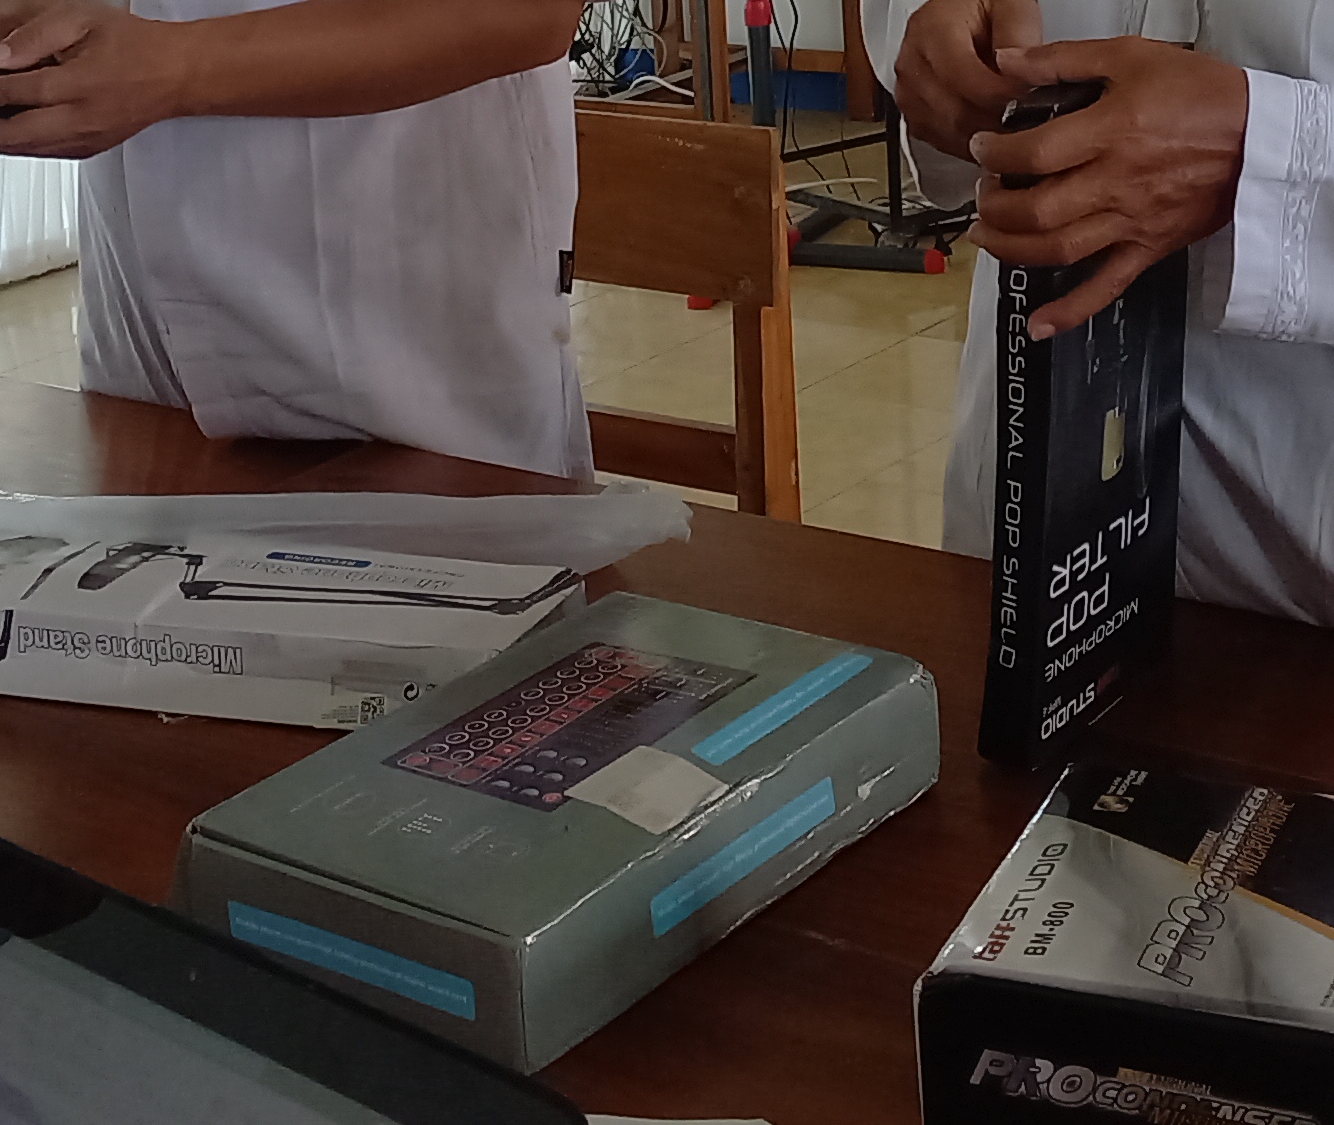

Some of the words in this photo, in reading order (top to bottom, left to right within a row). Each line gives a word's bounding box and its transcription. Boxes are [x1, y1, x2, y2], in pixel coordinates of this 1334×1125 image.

[1007, 263, 1027, 470] OFESSIONAL
[1004, 478, 1023, 547] POP
[1049, 496, 1151, 599] FILTER
[17, 625, 92, 660] Stand
[998, 555, 1020, 669] SHIELD
[1042, 597, 1139, 683] MICROPHONE
[1046, 572, 1110, 649] POP
[96, 633, 244, 676] Microphone
[1040, 682, 1095, 741] STUDIO
[1235, 794, 1295, 877] MICROPHONE
[1023, 901, 1075, 956] BM-800
